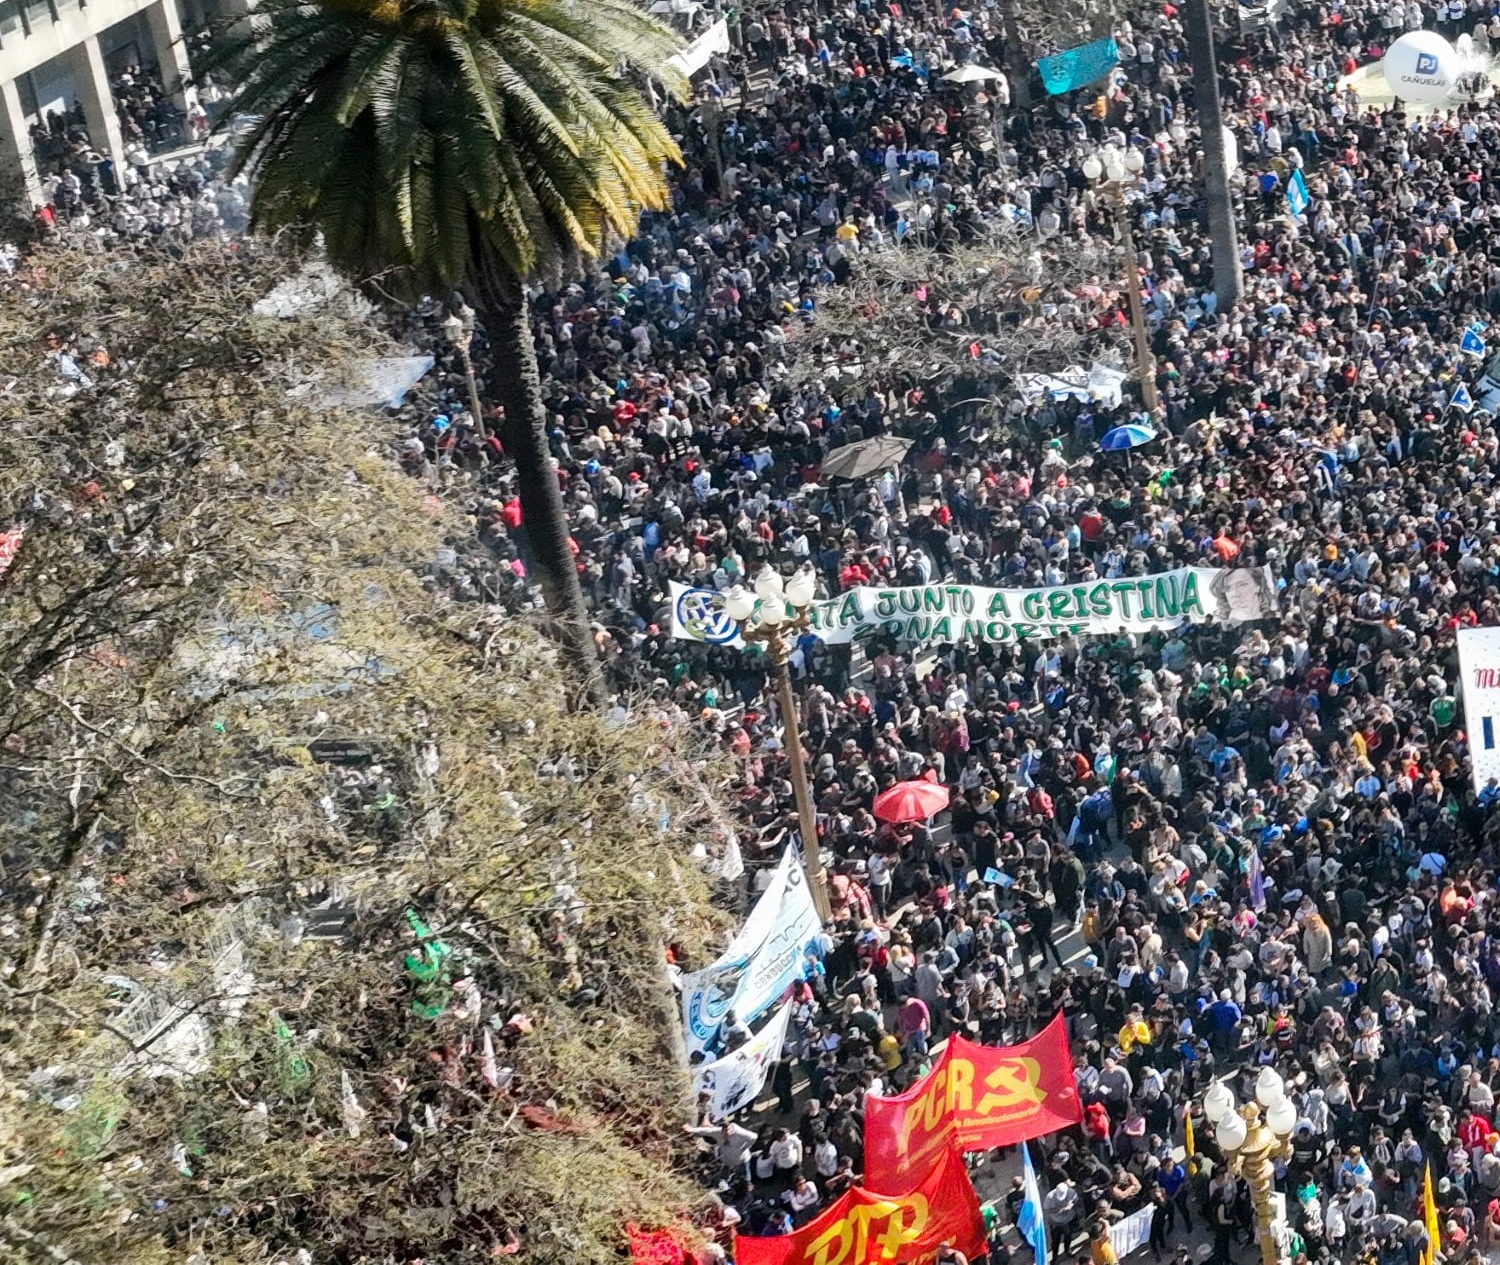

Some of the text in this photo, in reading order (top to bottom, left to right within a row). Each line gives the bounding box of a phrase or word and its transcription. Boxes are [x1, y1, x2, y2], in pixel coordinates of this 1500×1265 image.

[1419, 57, 1436, 71] PJ
[877, 587, 975, 617] JUNTO
[988, 592, 1011, 618] A
[1022, 572, 1205, 621] CRISTINA
